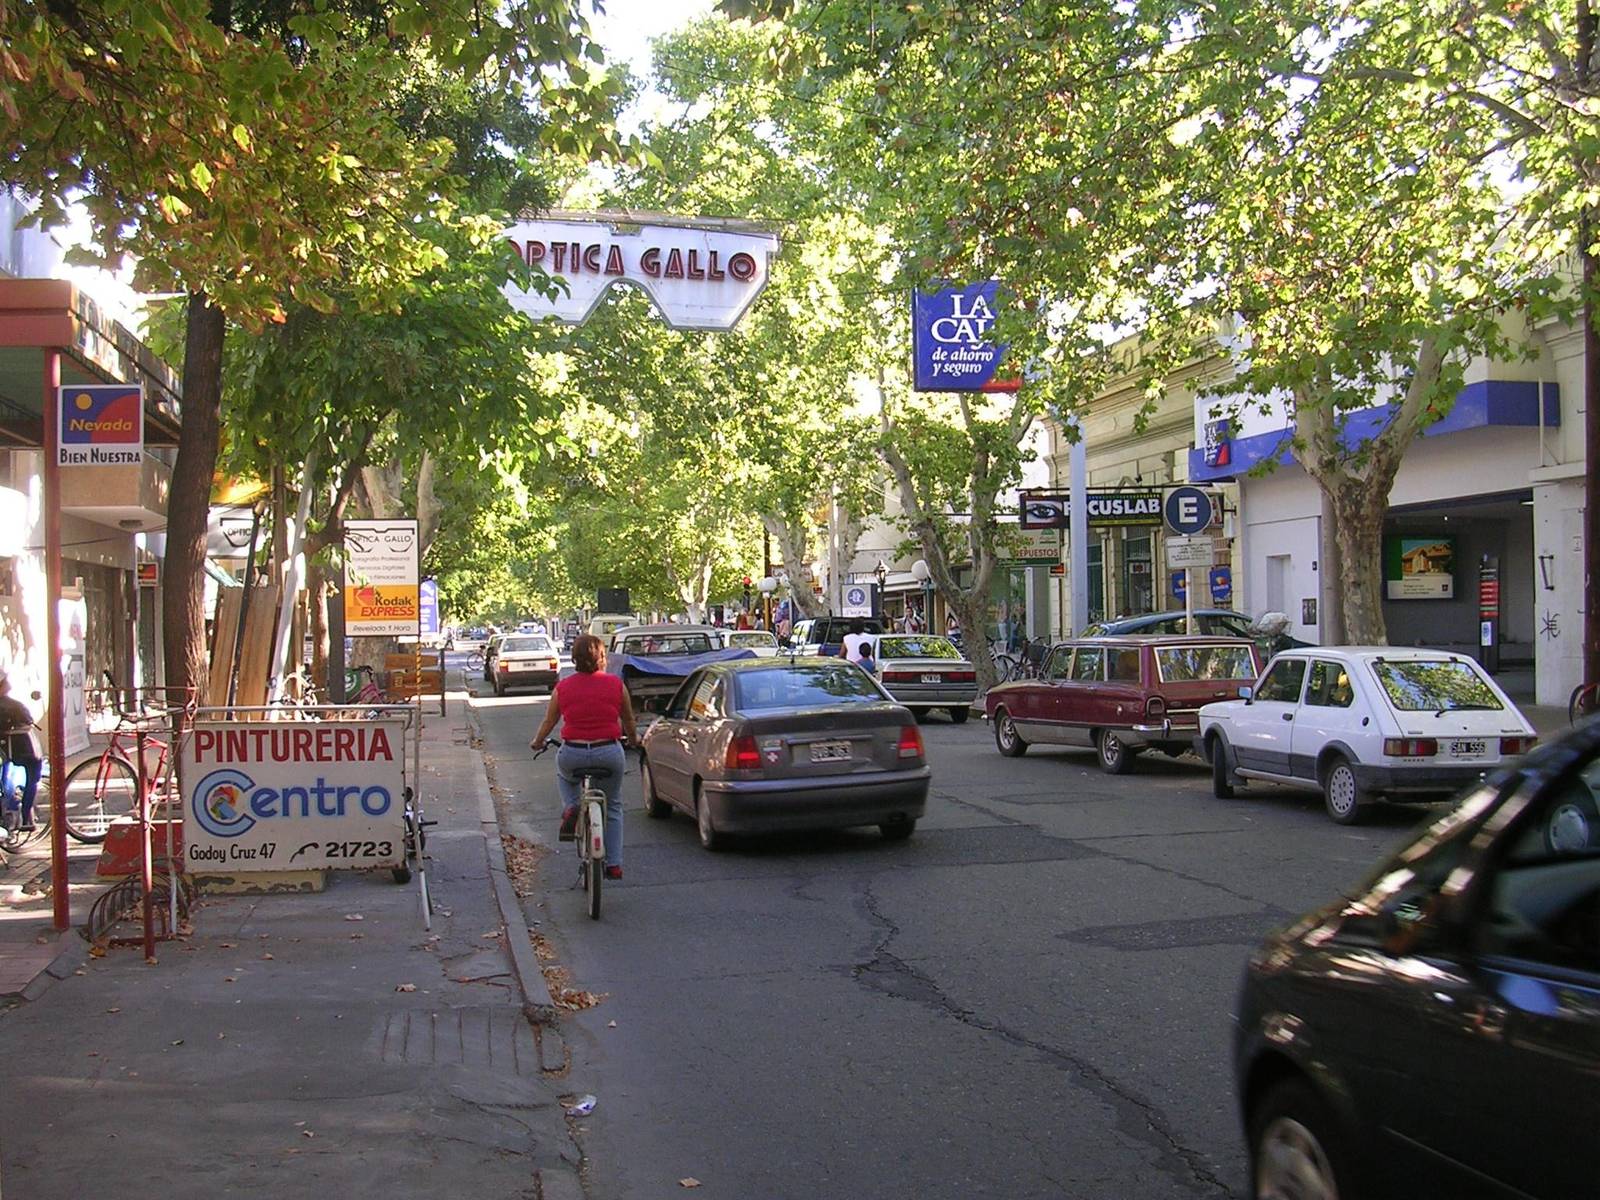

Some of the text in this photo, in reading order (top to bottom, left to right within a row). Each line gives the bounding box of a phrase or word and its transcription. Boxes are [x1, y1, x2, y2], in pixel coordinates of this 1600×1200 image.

[640, 247, 757, 281] GALLO
[950, 294, 995, 319] LA
[931, 318, 994, 350] CAJ
[932, 346, 994, 361] de ahorro
[932, 362, 982, 377] y seguro
[69, 418, 133, 432] Nevada
[1063, 498, 1160, 517] FCUSLAB
[1178, 497, 1198, 523] E
[384, 535, 412, 543] GALLO
[375, 595, 412, 606] Kodak
[361, 606, 415, 617] EXPRESS
[353, 624, 386, 633] Revelado
[394, 624, 411, 632] Hora
[194, 728, 393, 763] PINTURERIA
[192, 768, 392, 838] Centro
[189, 841, 393, 863] Godoy Cruz 47 21723
